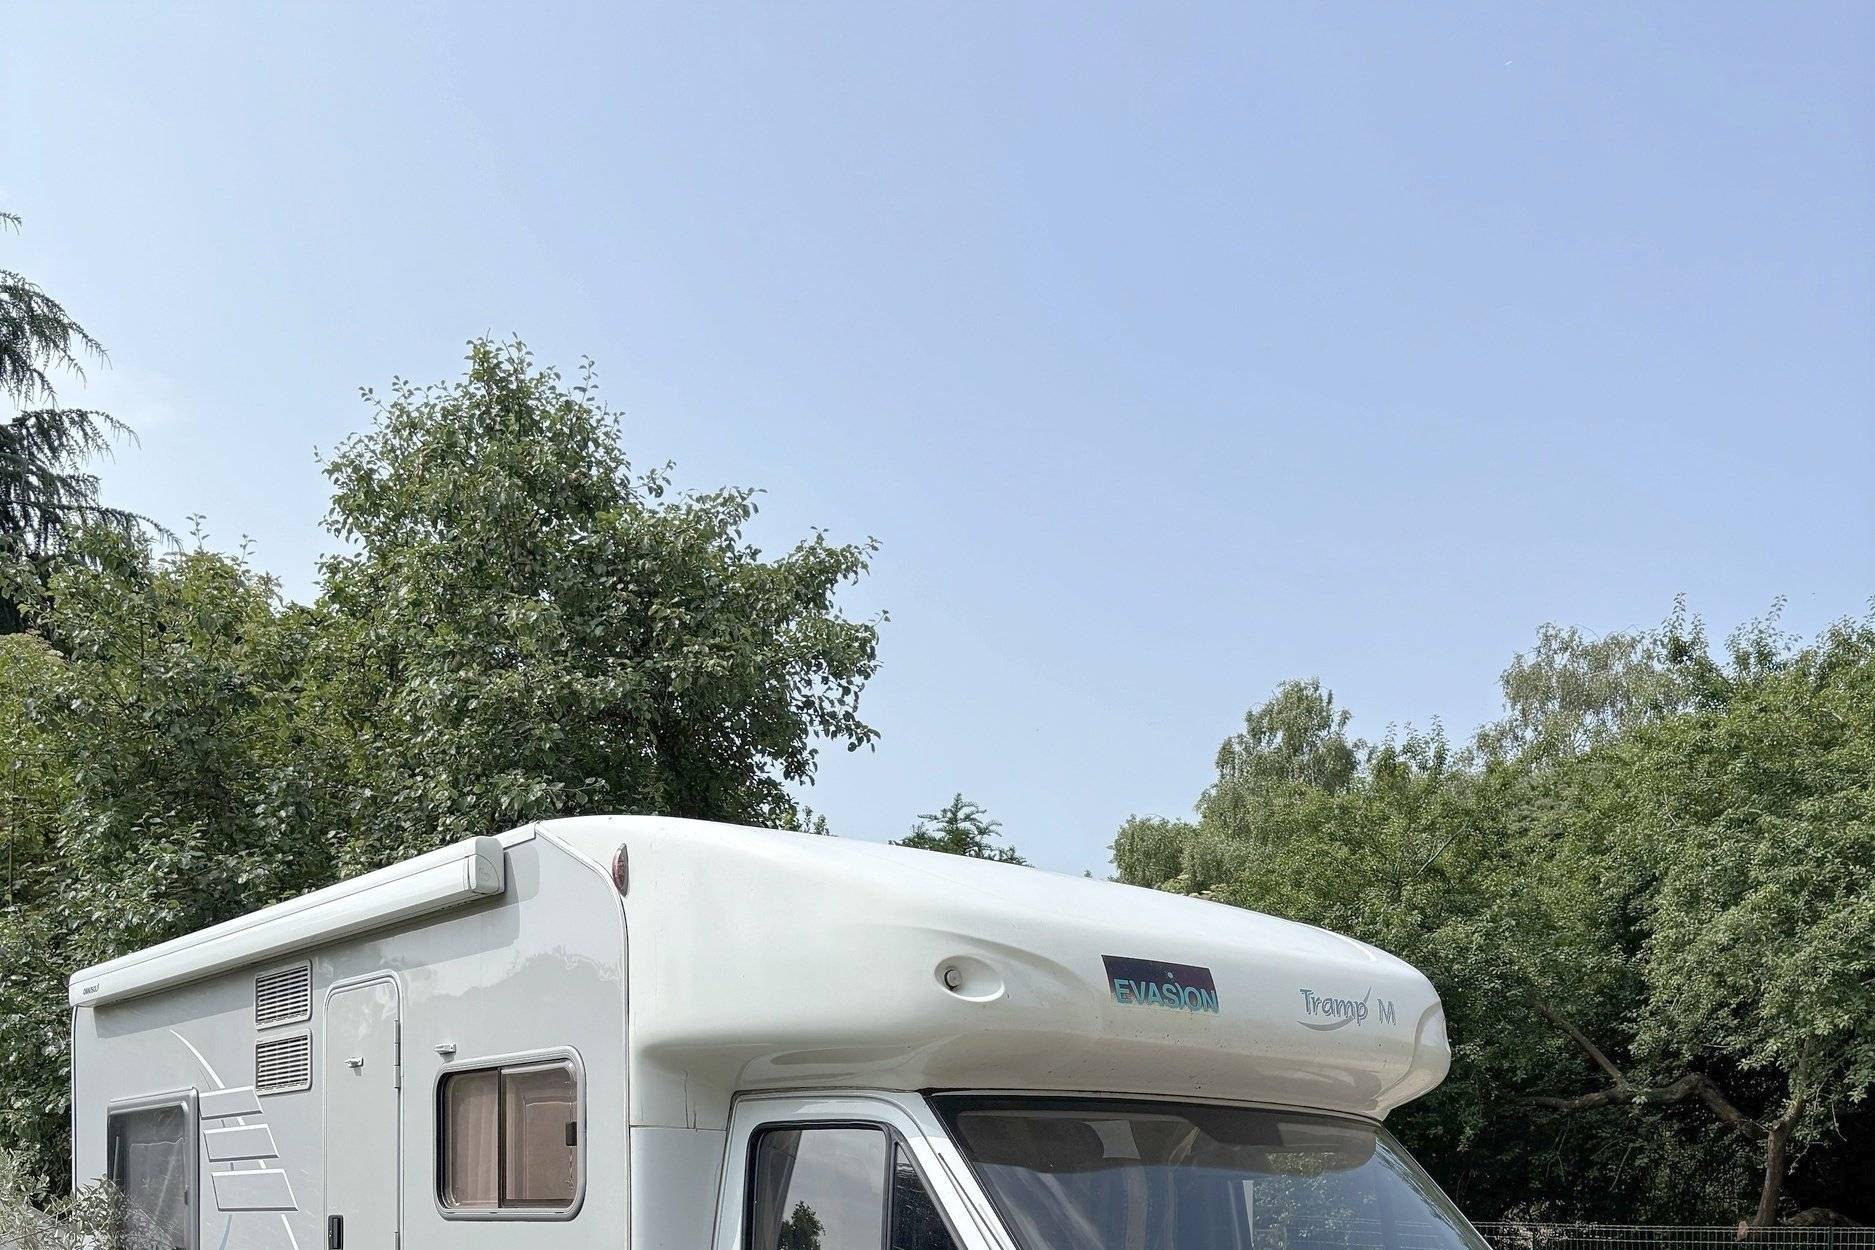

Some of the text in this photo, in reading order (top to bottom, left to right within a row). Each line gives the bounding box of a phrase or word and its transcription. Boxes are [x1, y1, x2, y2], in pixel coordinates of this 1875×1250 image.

[1113, 977, 1220, 1014] EVASION
[1299, 988, 1398, 1027] Tramp M
